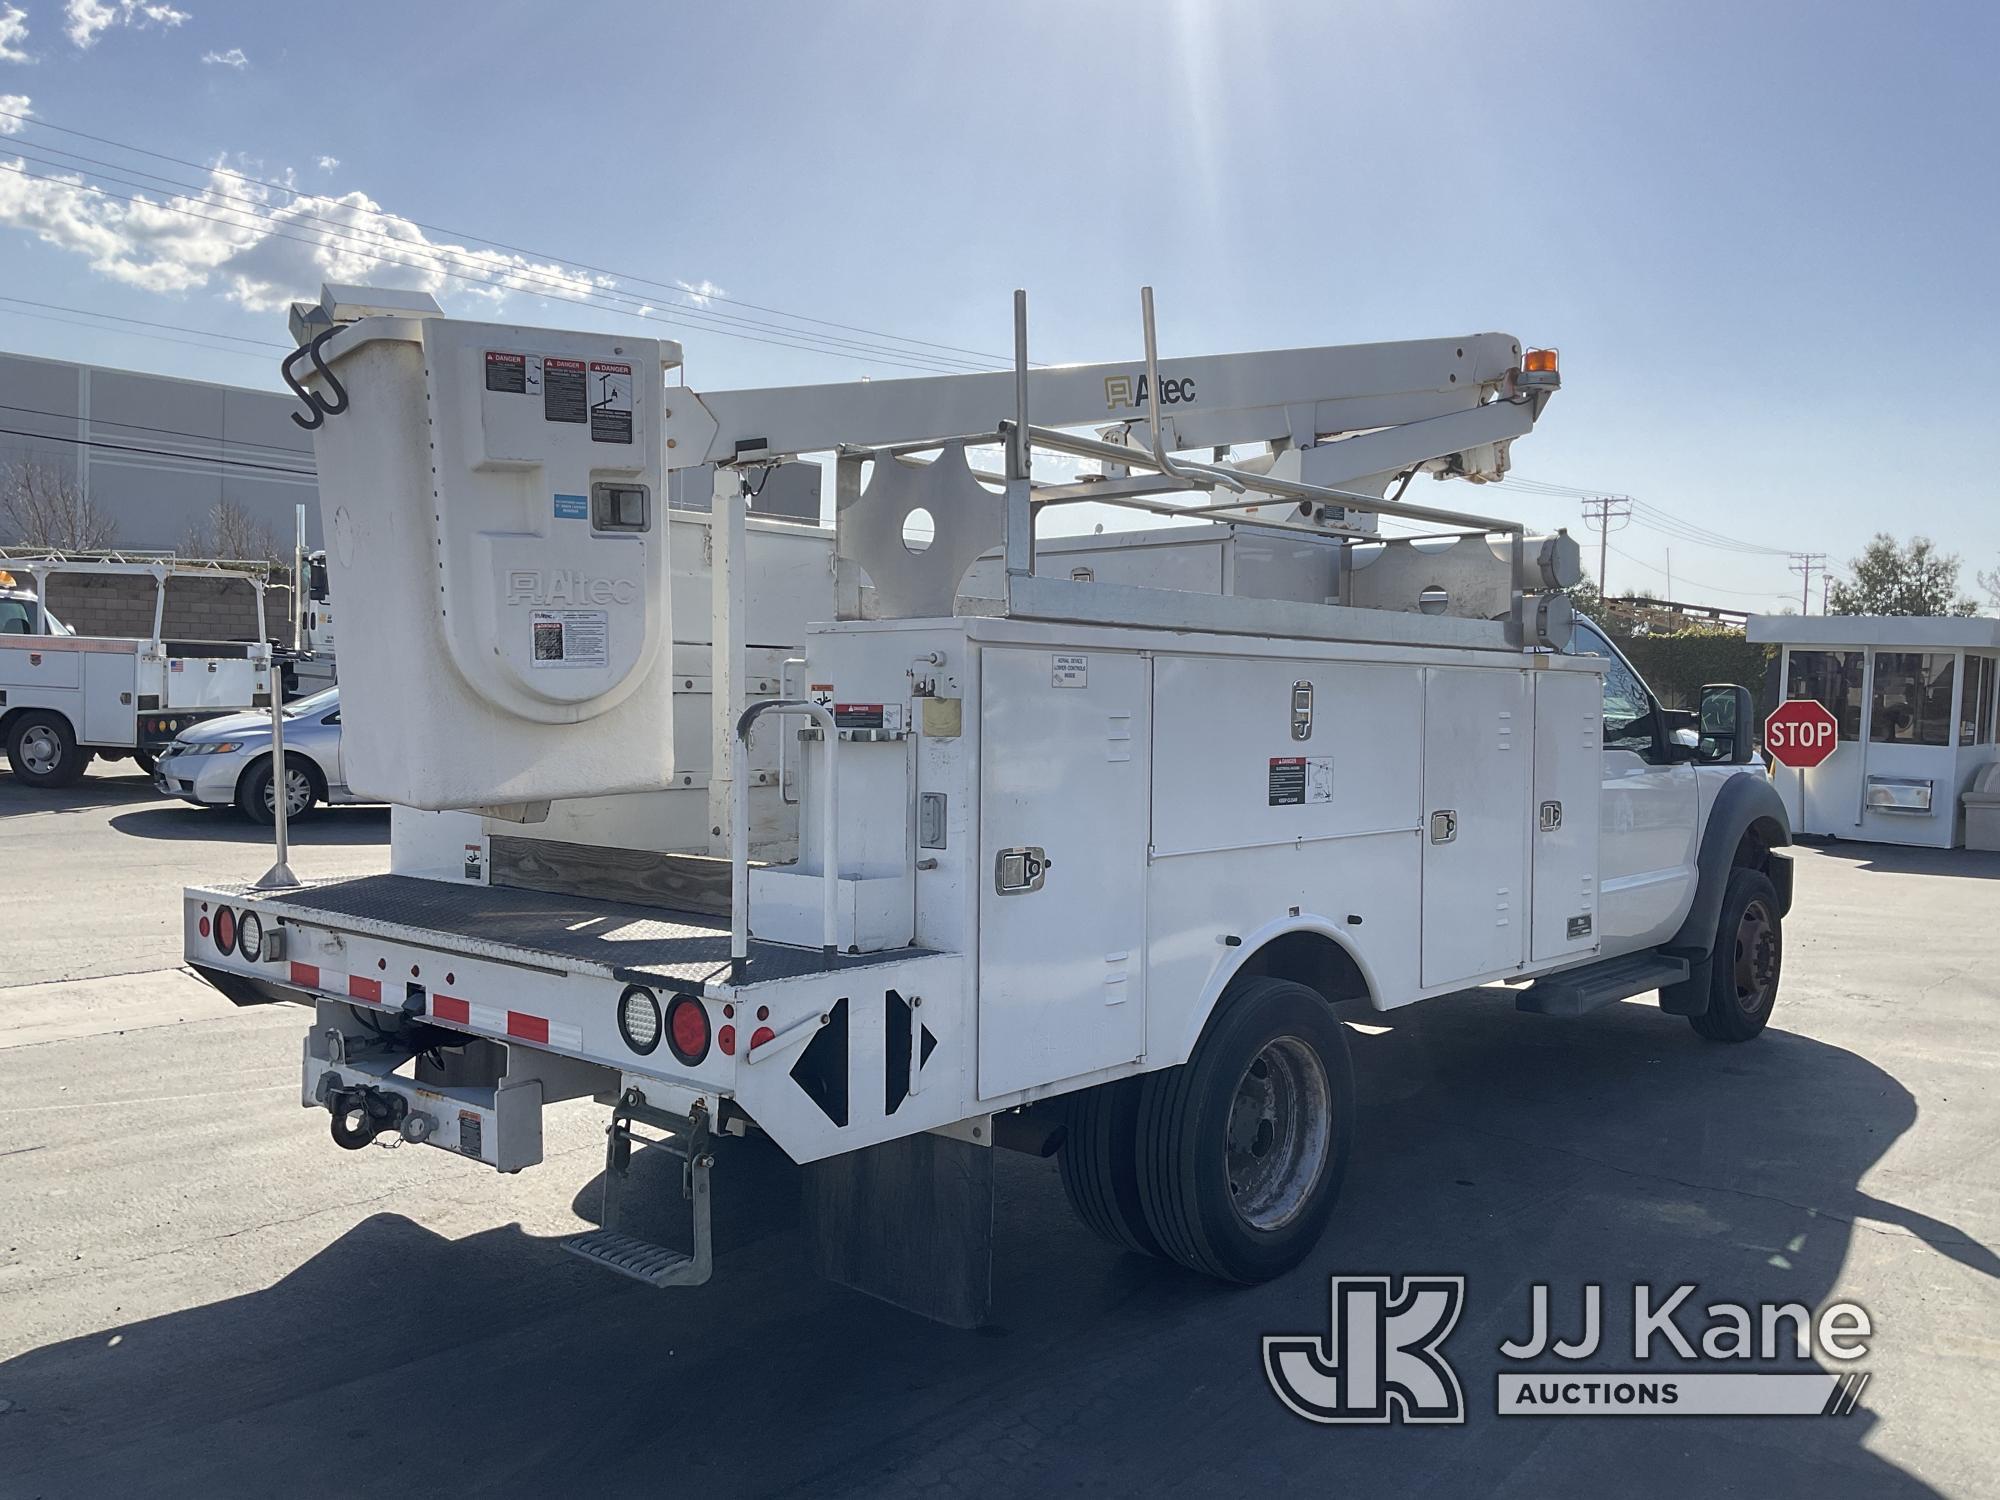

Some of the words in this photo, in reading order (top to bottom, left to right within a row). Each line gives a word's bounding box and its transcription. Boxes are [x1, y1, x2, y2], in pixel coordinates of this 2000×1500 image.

[495, 354, 521, 363] DANGER
[556, 361, 580, 369] DANGER
[601, 365, 629, 373] DANGER
[1135, 374, 1196, 407] Atec
[545, 569, 637, 606] Altec
[1770, 722, 1832, 747] STOP
